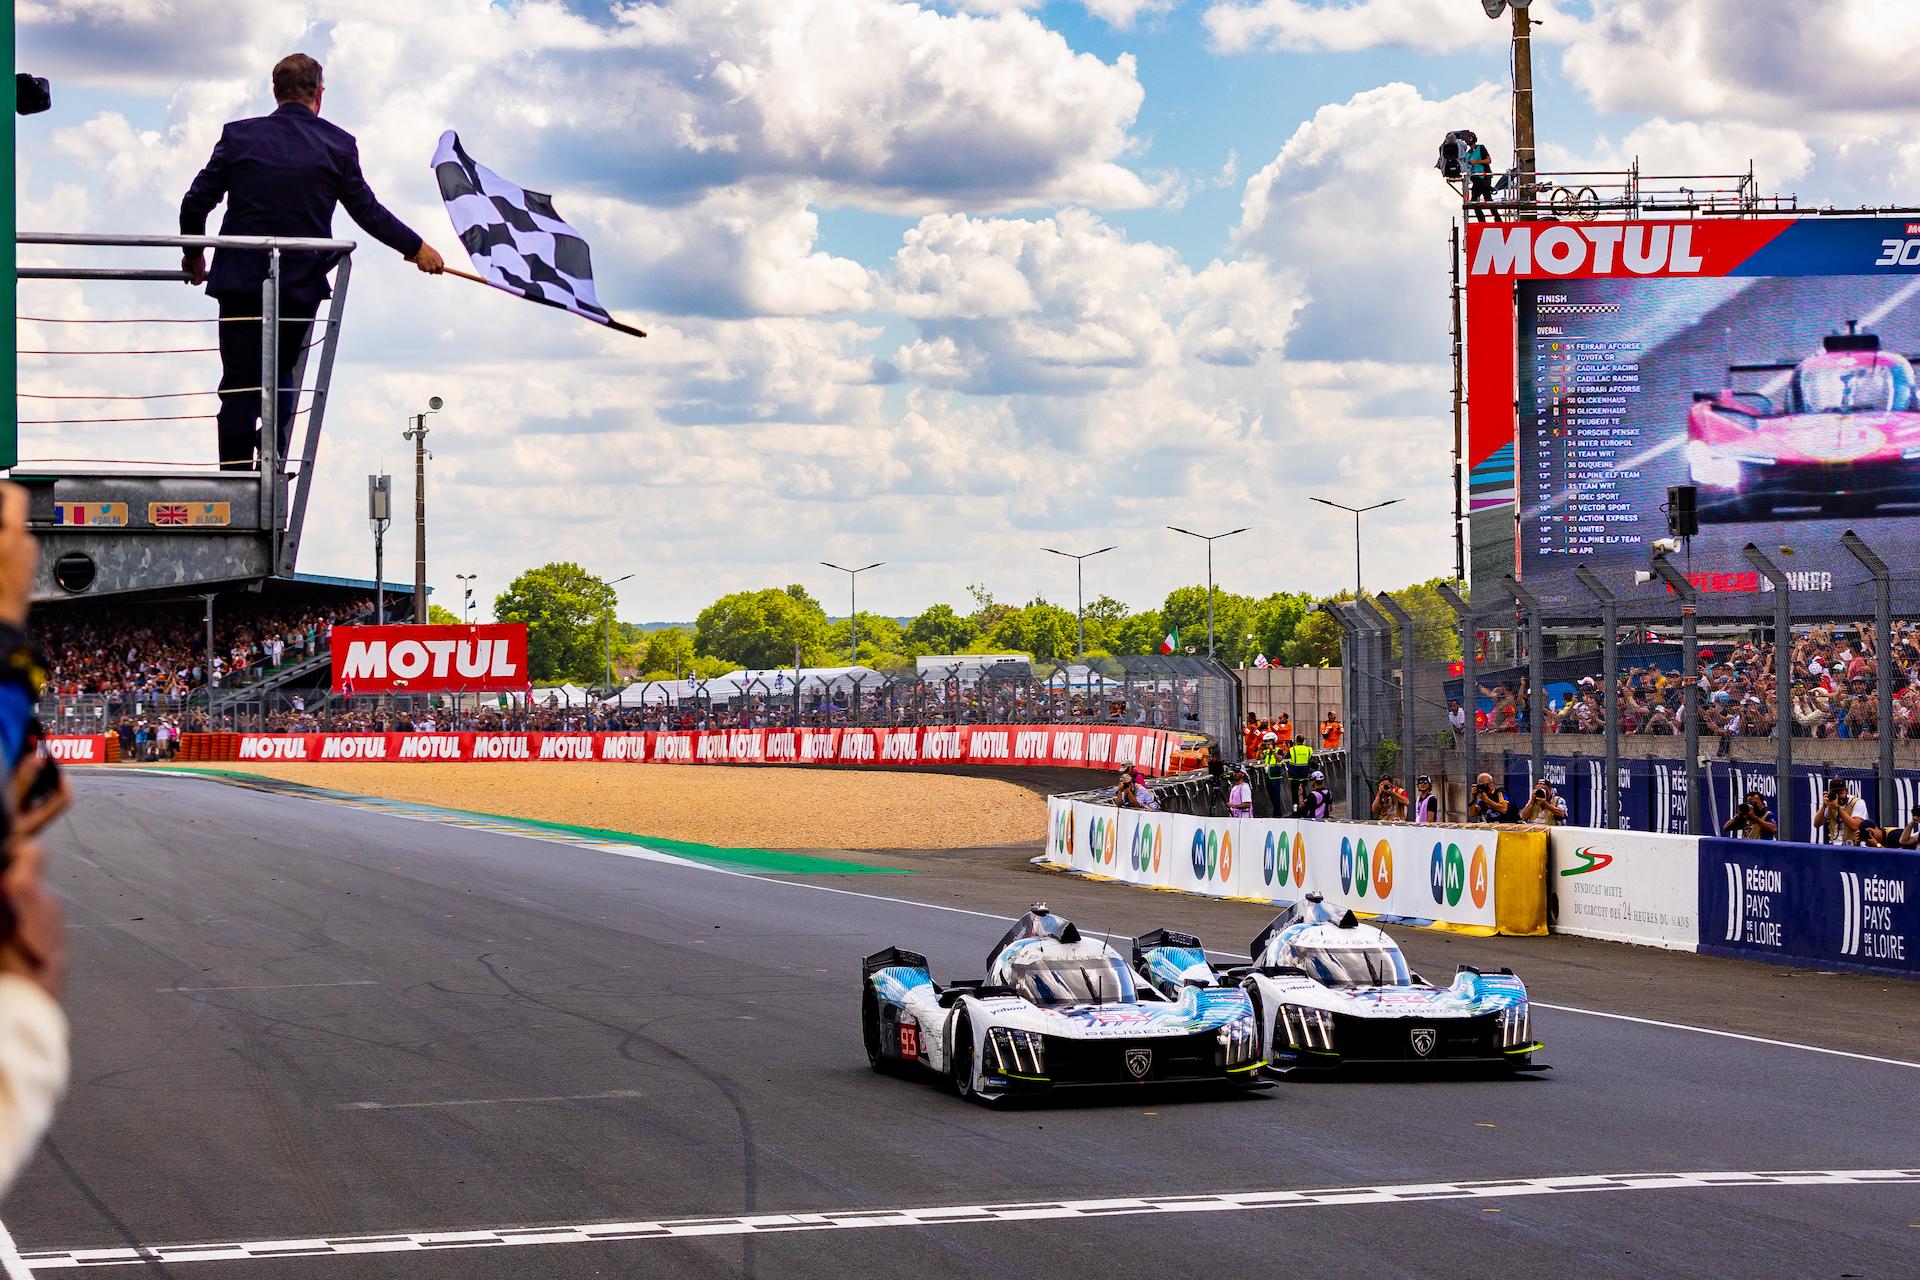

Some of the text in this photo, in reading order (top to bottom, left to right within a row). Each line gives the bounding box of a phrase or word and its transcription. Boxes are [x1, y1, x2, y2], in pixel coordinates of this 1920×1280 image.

[1471, 225, 1702, 275] MOTUL
[1537, 294, 1568, 303] FINISH
[1537, 326, 1564, 335] OVERALL
[1608, 342, 1640, 350] AFCORSE
[1612, 363, 1639, 371] RACING
[1612, 374, 1640, 382] RACING
[1608, 385, 1641, 393] AFCORSE
[1577, 407, 1627, 415] GLICKENHAUS
[1612, 428, 1641, 436] PENSKE
[1578, 461, 1614, 469] DUQUEINE
[1597, 492, 1620, 500] SPORT
[1607, 503, 1631, 511] SPORT
[1578, 514, 1605, 522] ACTION
[1606, 514, 1639, 522] EXPRESS
[1578, 525, 1605, 533] UNITED
[1621, 535, 1642, 543] TEAM
[341, 639, 517, 679] MOTUL
[239, 738, 307, 759] MOTUL
[322, 737, 387, 759] MOTUL
[400, 736, 461, 759] MOTUL
[474, 737, 530, 759] MOTUL
[540, 737, 594, 759] MOTUL
[603, 736, 646, 759] MOTUL
[655, 736, 691, 759] MOTUL
[697, 735, 729, 759] MOTUL
[730, 733, 762, 759] MOTUL
[767, 733, 796, 759] MOTUL
[801, 734, 835, 759] MOTUL
[842, 733, 875, 760] MOTUL
[882, 733, 919, 760] MOTUL
[922, 732, 961, 760] MOTUL
[970, 732, 1009, 759] MOTUL
[1746, 770, 1777, 798] RÉGION
[1671, 794, 1687, 817] PAY
[1573, 882, 1622, 898] SYNDICAT MIXTE
[1746, 865, 1781, 893] RÉGION
[1864, 874, 1904, 904] RÉGION
[1574, 902, 1583, 915] DU
[1584, 903, 1608, 918] CIRCUIT
[1610, 906, 1621, 919] DES
[1622, 901, 1632, 921] 24
[1633, 910, 1659, 924] HEURES
[1660, 912, 1670, 925] DU
[1746, 894, 1770, 919] PAYS
[1864, 905, 1891, 931] PAYS
[1746, 920, 1753, 931] DE
[1746, 921, 1782, 947] LA LOIRE
[1864, 932, 1872, 944] DE
[1865, 933, 1905, 961] LA LOIRE
[900, 1028, 917, 1056] 93
[1085, 1028, 1181, 1037] PEUGEOT
